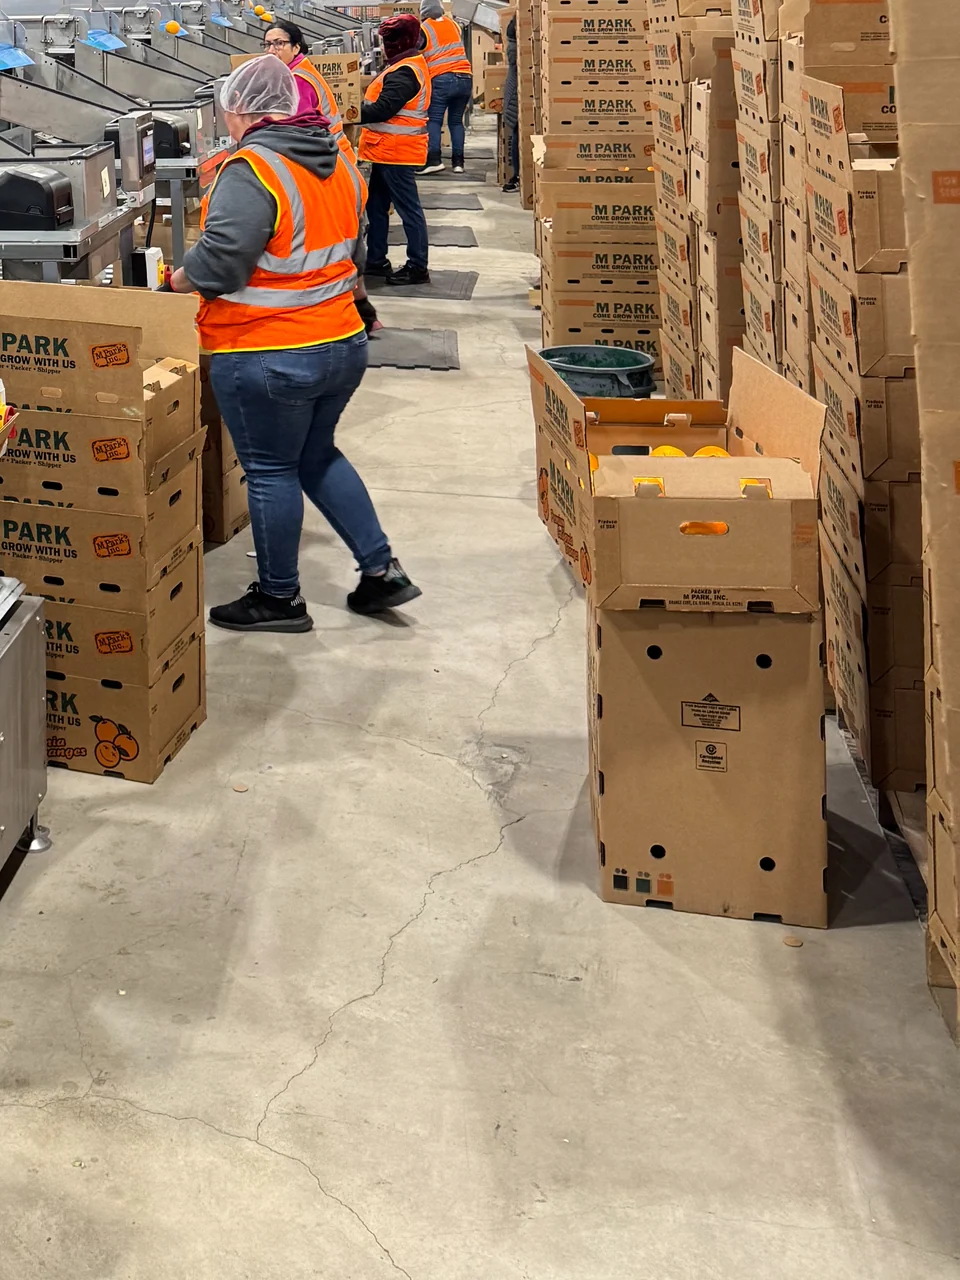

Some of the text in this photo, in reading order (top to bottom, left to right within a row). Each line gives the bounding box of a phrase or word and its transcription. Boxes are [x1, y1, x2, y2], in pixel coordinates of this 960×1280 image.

[584, 19, 633, 28] M PARK
[322, 62, 342, 72] PARK
[584, 59, 634, 68] M PARK
[584, 99, 634, 108] M PARK
[579, 143, 632, 153] M PARK
[594, 205, 654, 215] M PARK
[595, 253, 654, 265] M PARK
[596, 302, 656, 314] M PARK
[2, 332, 70, 358] PARK
[95, 351, 105, 360] M
[105, 355, 121, 364] Inc.
[0, 354, 31, 365] GROW
[33, 356, 59, 369] WITH
[62, 359, 76, 369] US
[37, 366, 61, 375] Shipper
[545, 381, 570, 431] M PARK
[17, 427, 71, 452] ARK
[95, 446, 105, 455] M
[105, 449, 121, 459] Inc.
[33, 450, 60, 463] WITH
[63, 453, 77, 463] US
[10, 458, 62, 469] Packer Shipper
[550, 458, 556, 486] M
[556, 466, 576, 516] PARK
[3, 519, 72, 547] PARK
[1, 541, 78, 559] GROW WITH US
[96, 541, 106, 550] M
[106, 546, 123, 555] Inc.
[12, 552, 63, 564] Packer Shipper
[98, 637, 108, 647] M
[109, 641, 125, 651] Inc.
[66, 644, 80, 655] US
[68, 716, 82, 727] US
